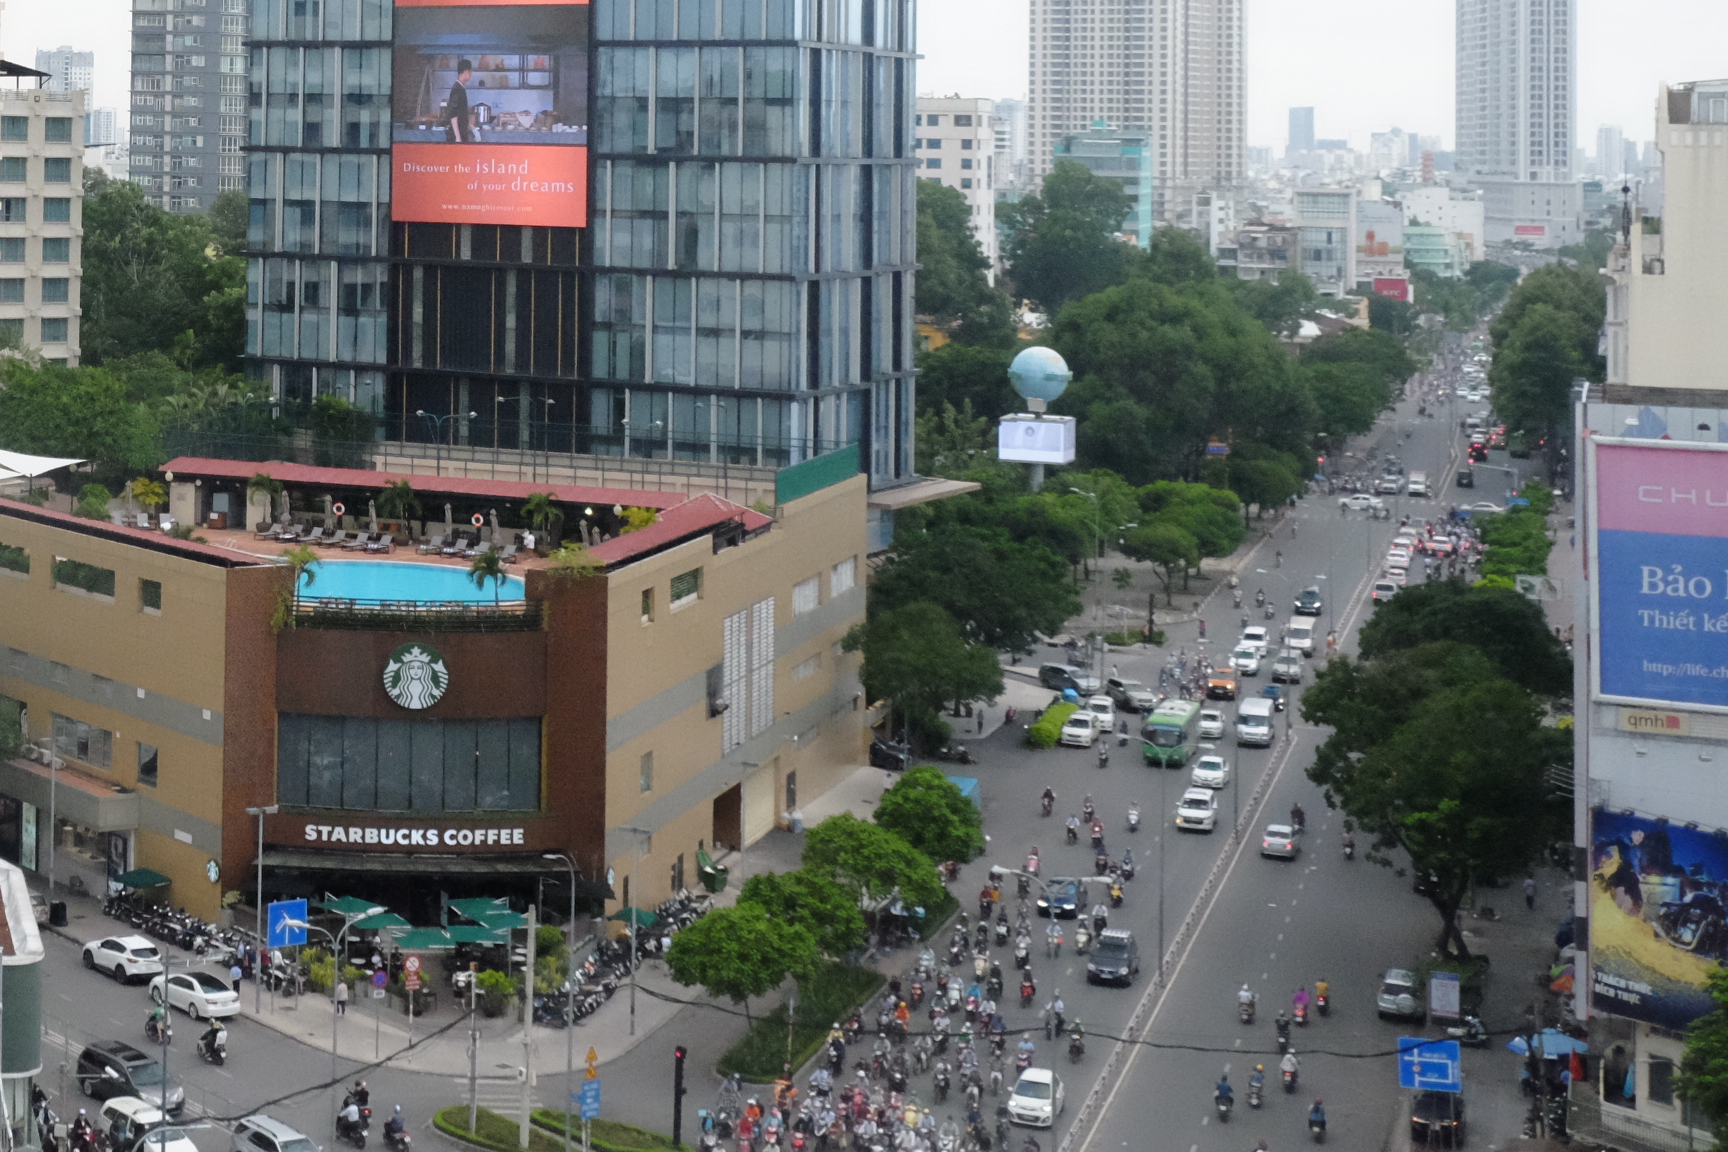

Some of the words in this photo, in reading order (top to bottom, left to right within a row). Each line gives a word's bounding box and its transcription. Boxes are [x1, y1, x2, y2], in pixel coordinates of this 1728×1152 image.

[403, 162, 450, 173] Discover
[454, 163, 471, 173] the
[476, 158, 529, 175] island
[467, 180, 478, 190] of
[482, 182, 506, 194] your
[511, 175, 574, 193] dreams
[1640, 564, 1712, 599] Bảo
[1638, 609, 1697, 631] Thiết
[1627, 714, 1665, 730] qmh
[305, 824, 439, 846] STARBUCKS
[443, 828, 525, 846] COFFEE
